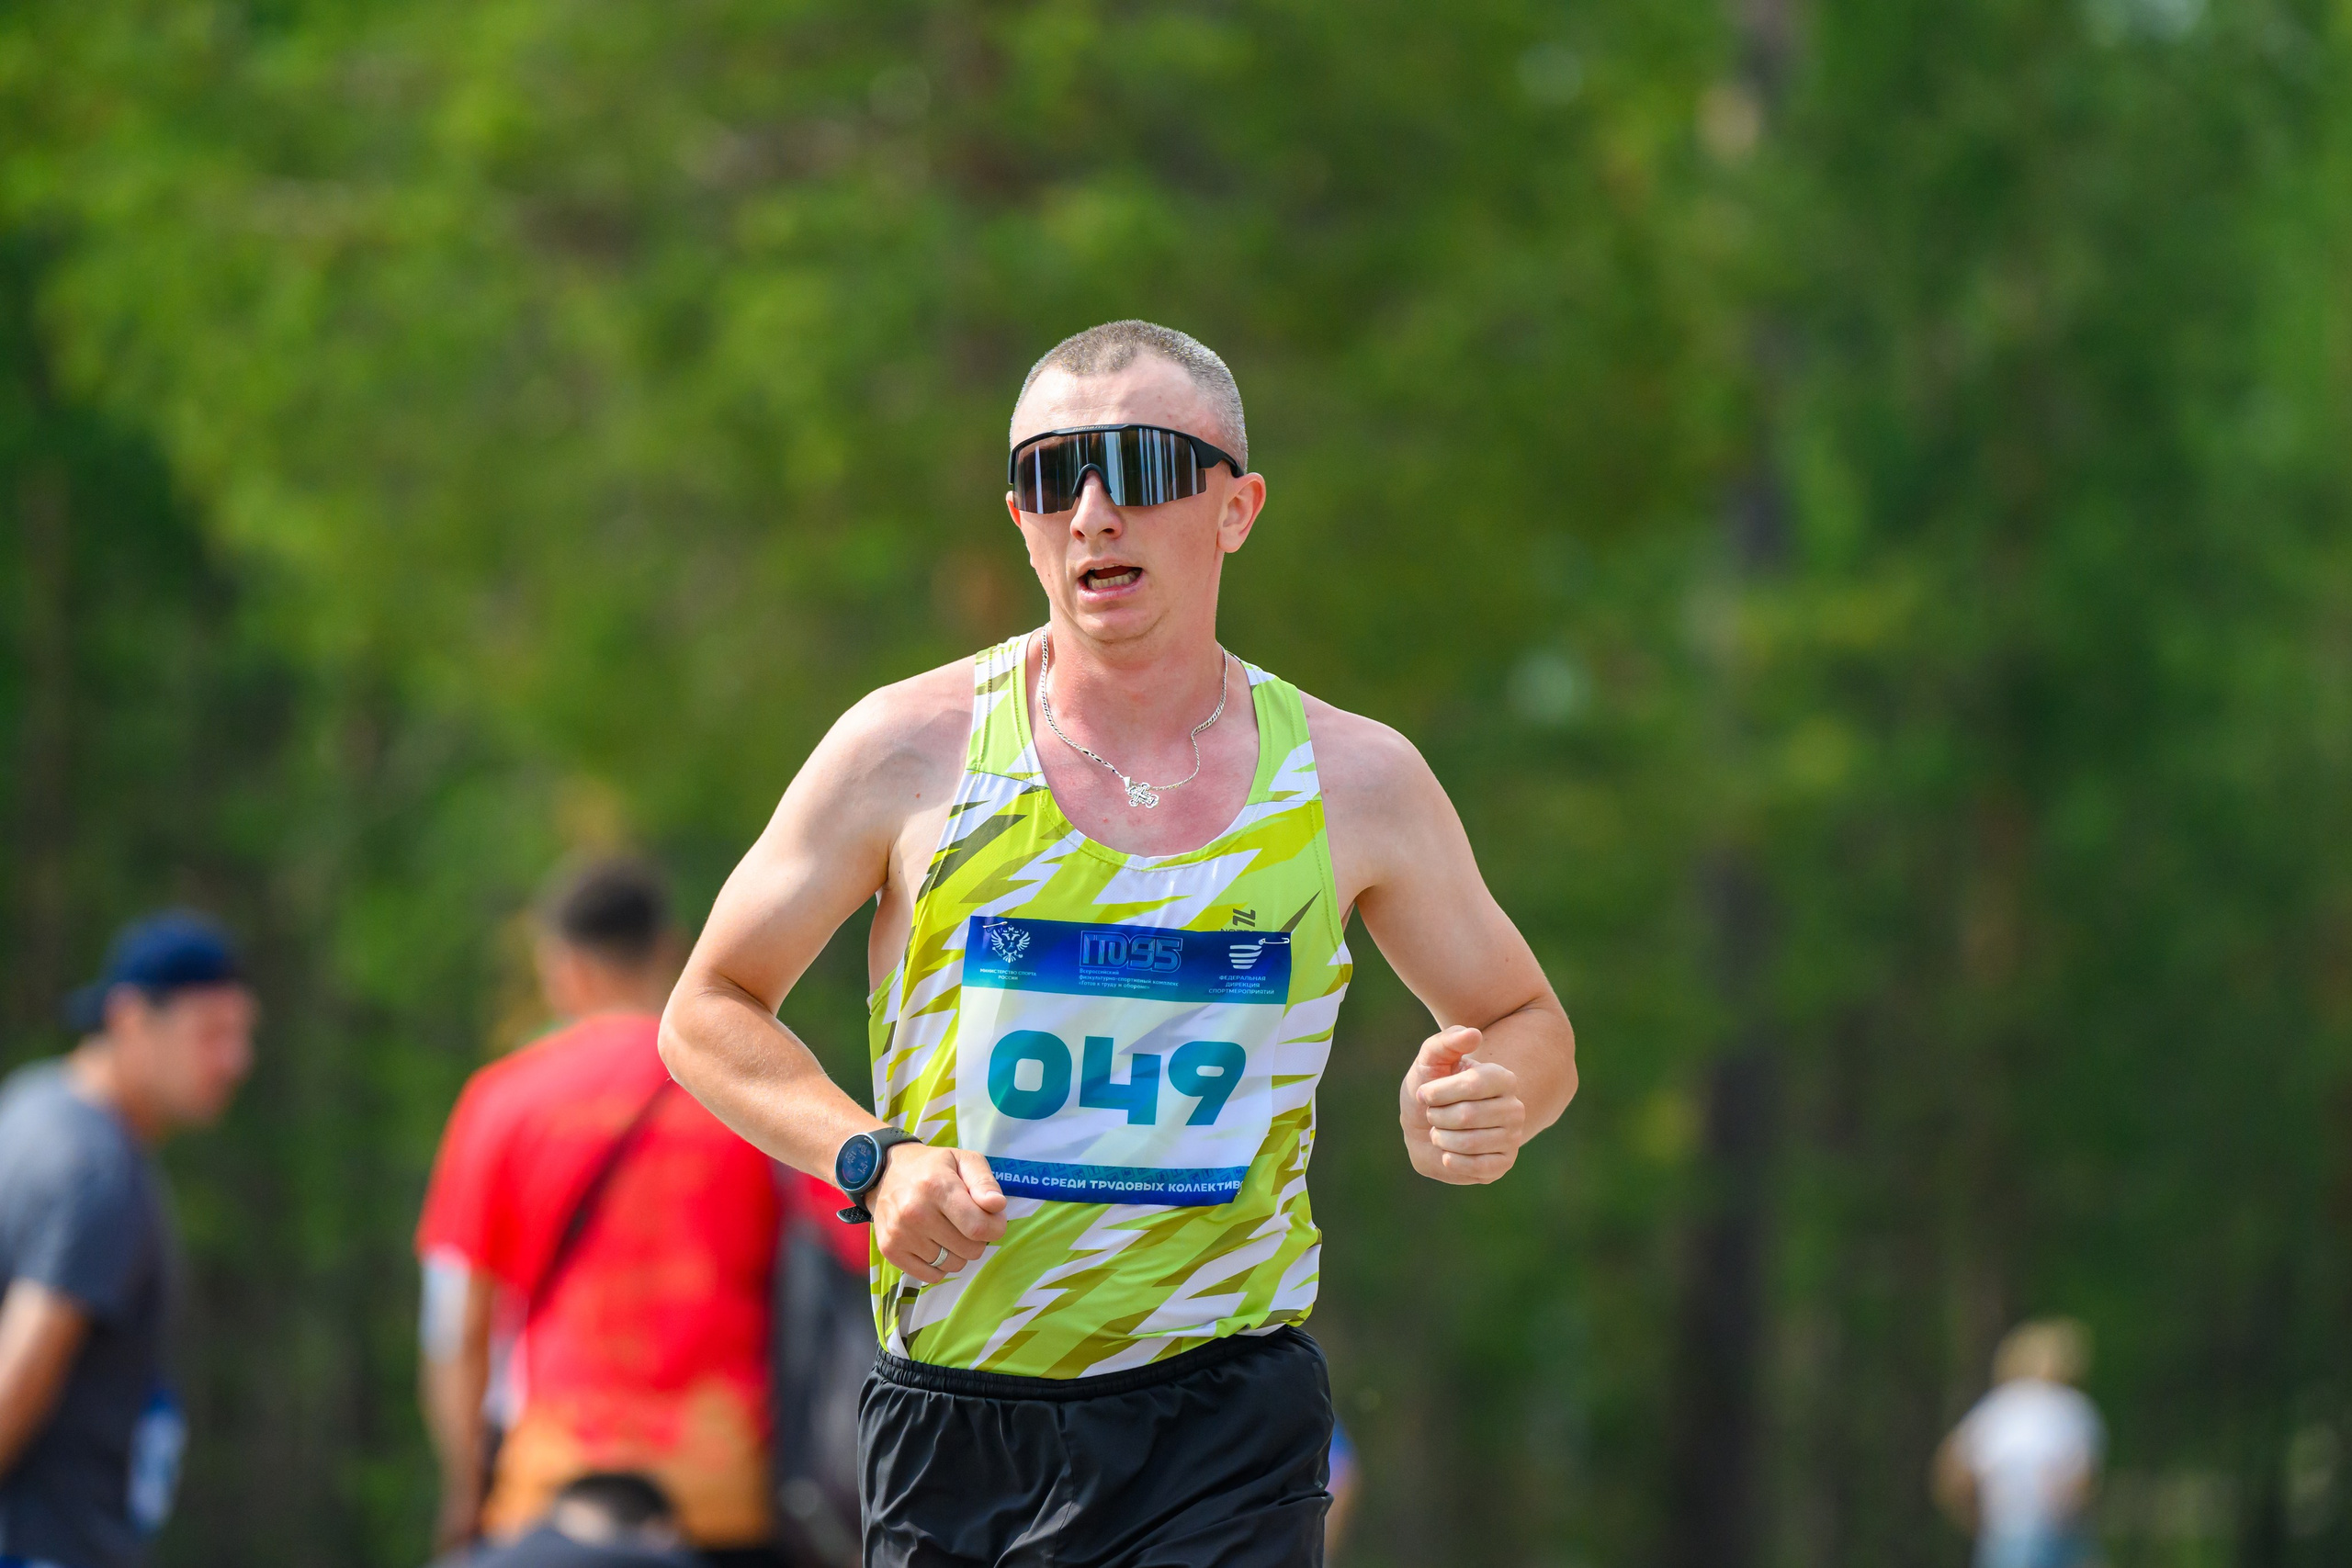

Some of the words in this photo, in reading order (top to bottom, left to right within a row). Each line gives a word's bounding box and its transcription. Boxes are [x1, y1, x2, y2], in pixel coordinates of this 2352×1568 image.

[988, 1030, 1247, 1126] 049
[992, 1171, 1039, 1184] ИВАЛЬ
[1042, 1177, 1086, 1189] СРЕДИ
[1090, 1179, 1164, 1191] ТРУДОВЫХ
